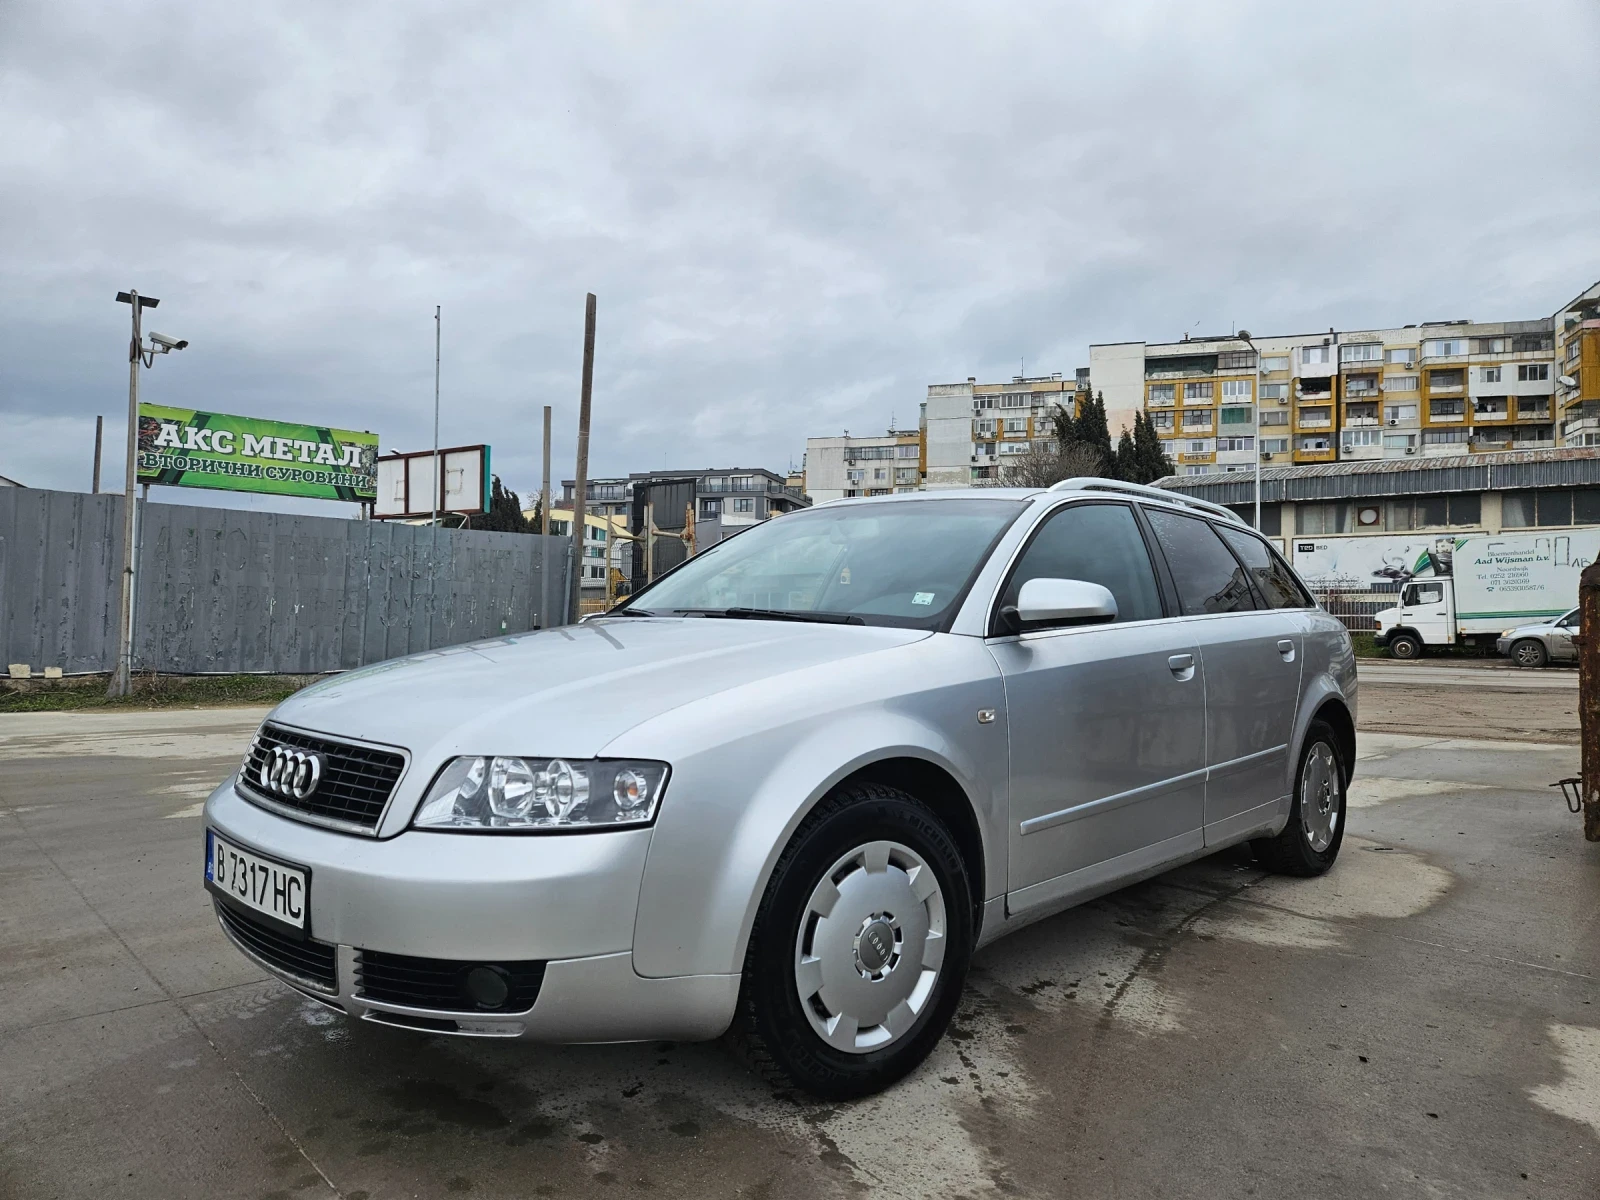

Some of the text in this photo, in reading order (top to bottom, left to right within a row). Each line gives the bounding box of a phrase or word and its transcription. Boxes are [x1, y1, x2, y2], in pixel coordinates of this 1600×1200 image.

[153, 422, 363, 468] АКС МЕТАЛ
[143, 452, 369, 489] ВТОРИЧНИ СУРОВИНИ
[1487, 549, 1535, 557] Bloemenhandel
[1495, 556, 1534, 565] Wijsman
[230, 851, 269, 906] 7317
[273, 869, 302, 920] HC
